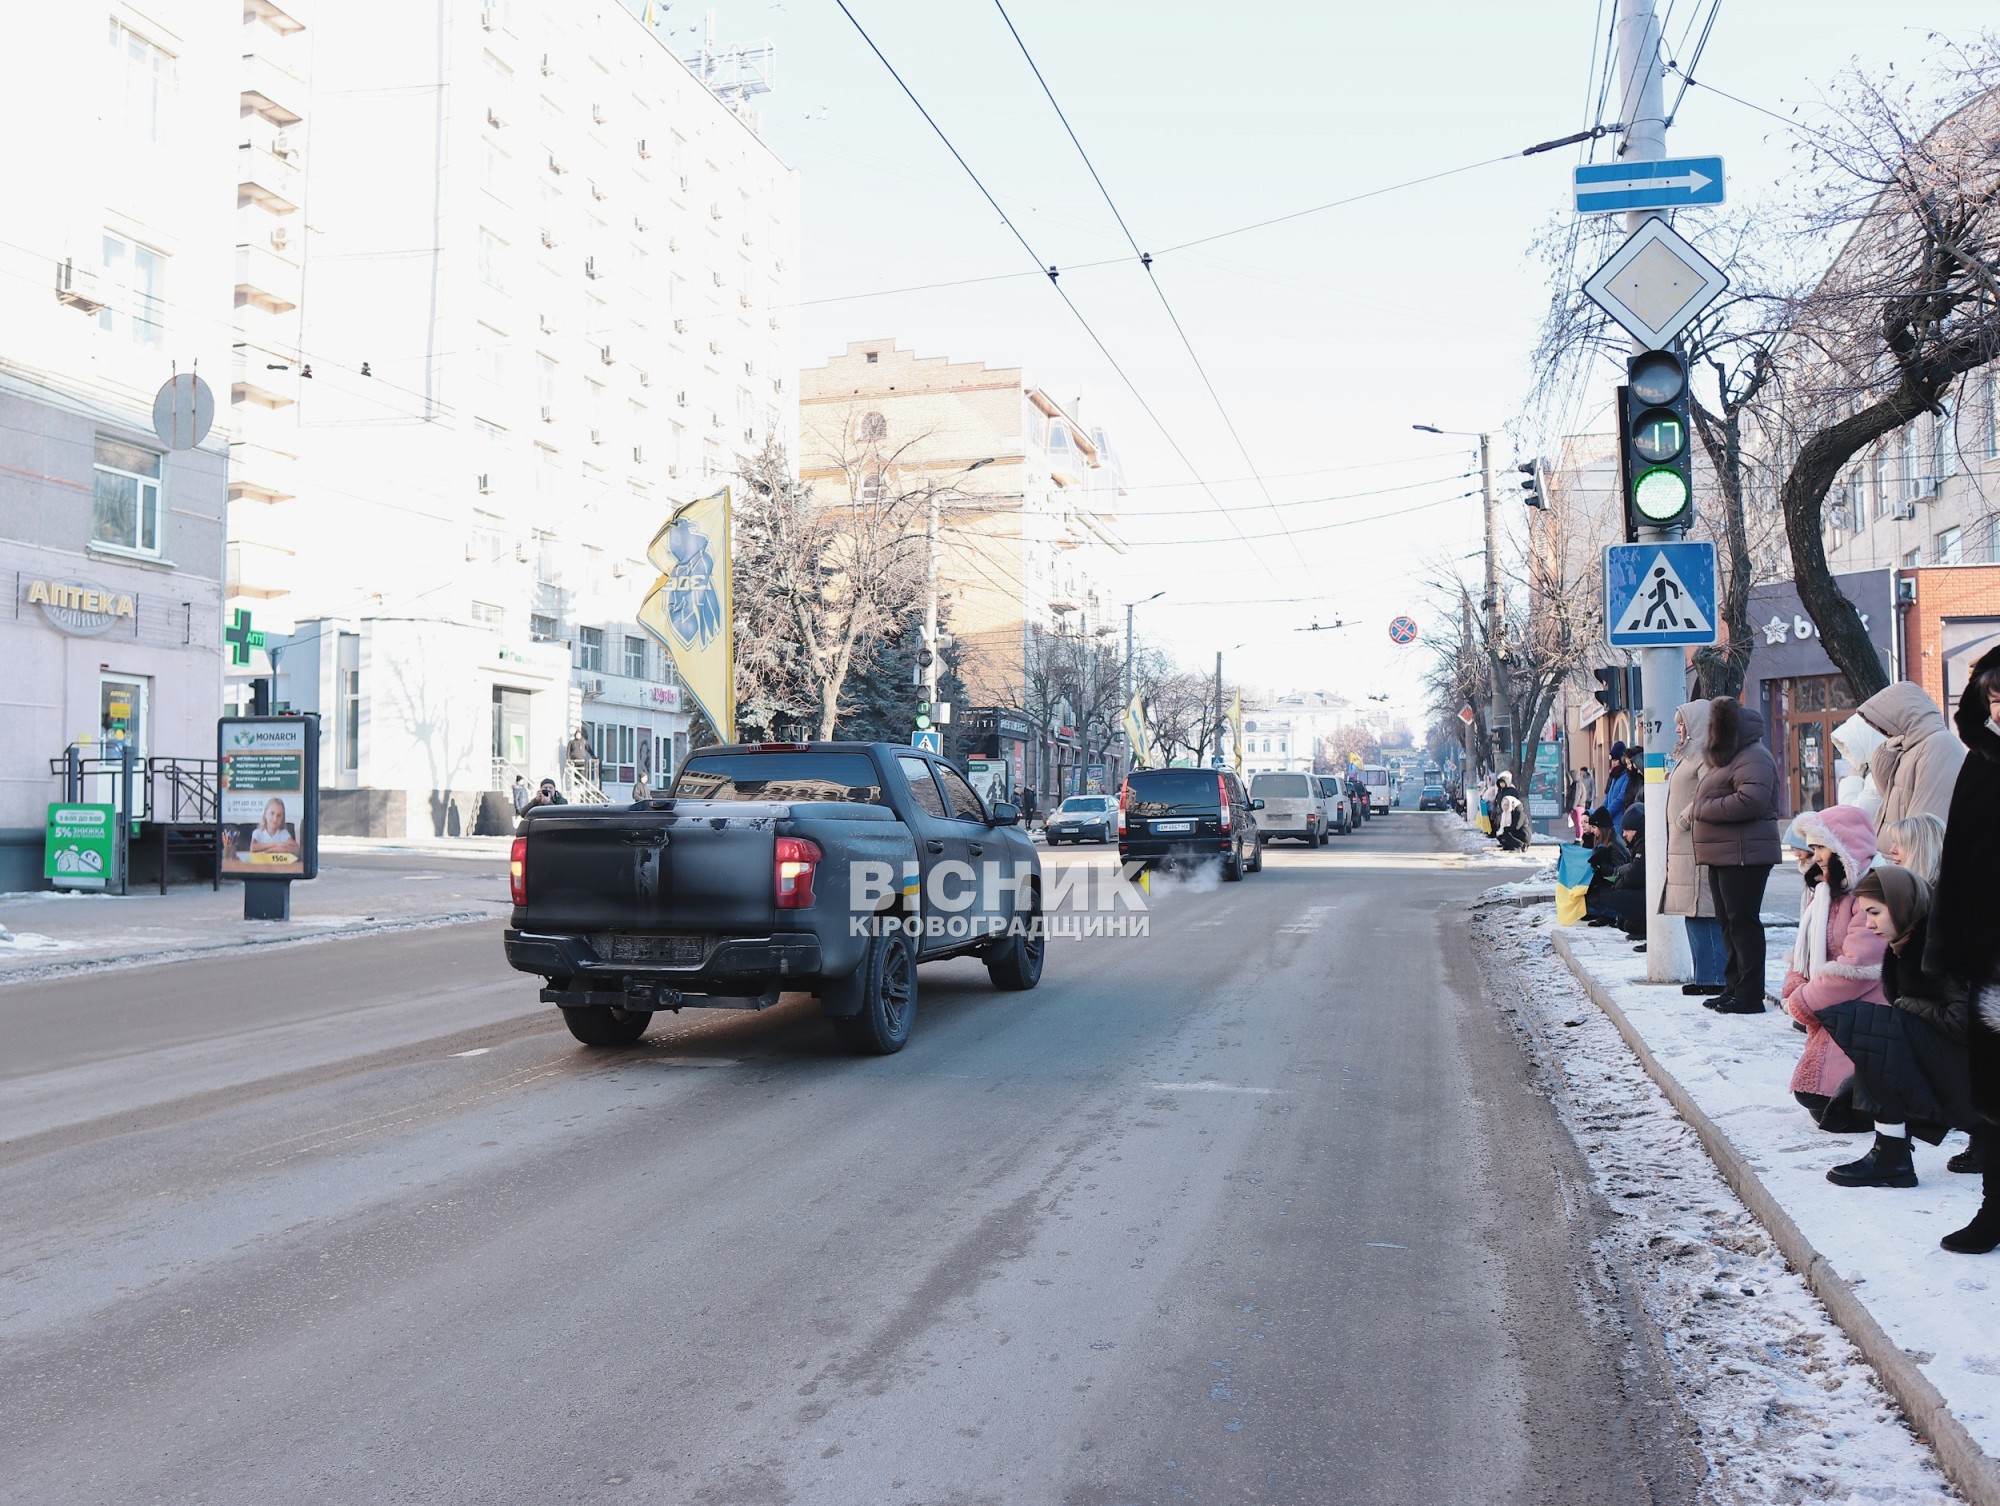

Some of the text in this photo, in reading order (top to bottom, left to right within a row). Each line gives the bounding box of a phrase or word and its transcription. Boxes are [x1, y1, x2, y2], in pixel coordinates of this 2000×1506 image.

[1654, 421, 1680, 453] 17
[28, 580, 135, 619] АПТЕКА
[256, 732, 297, 741] MONARCH
[55, 826, 72, 838] 5%
